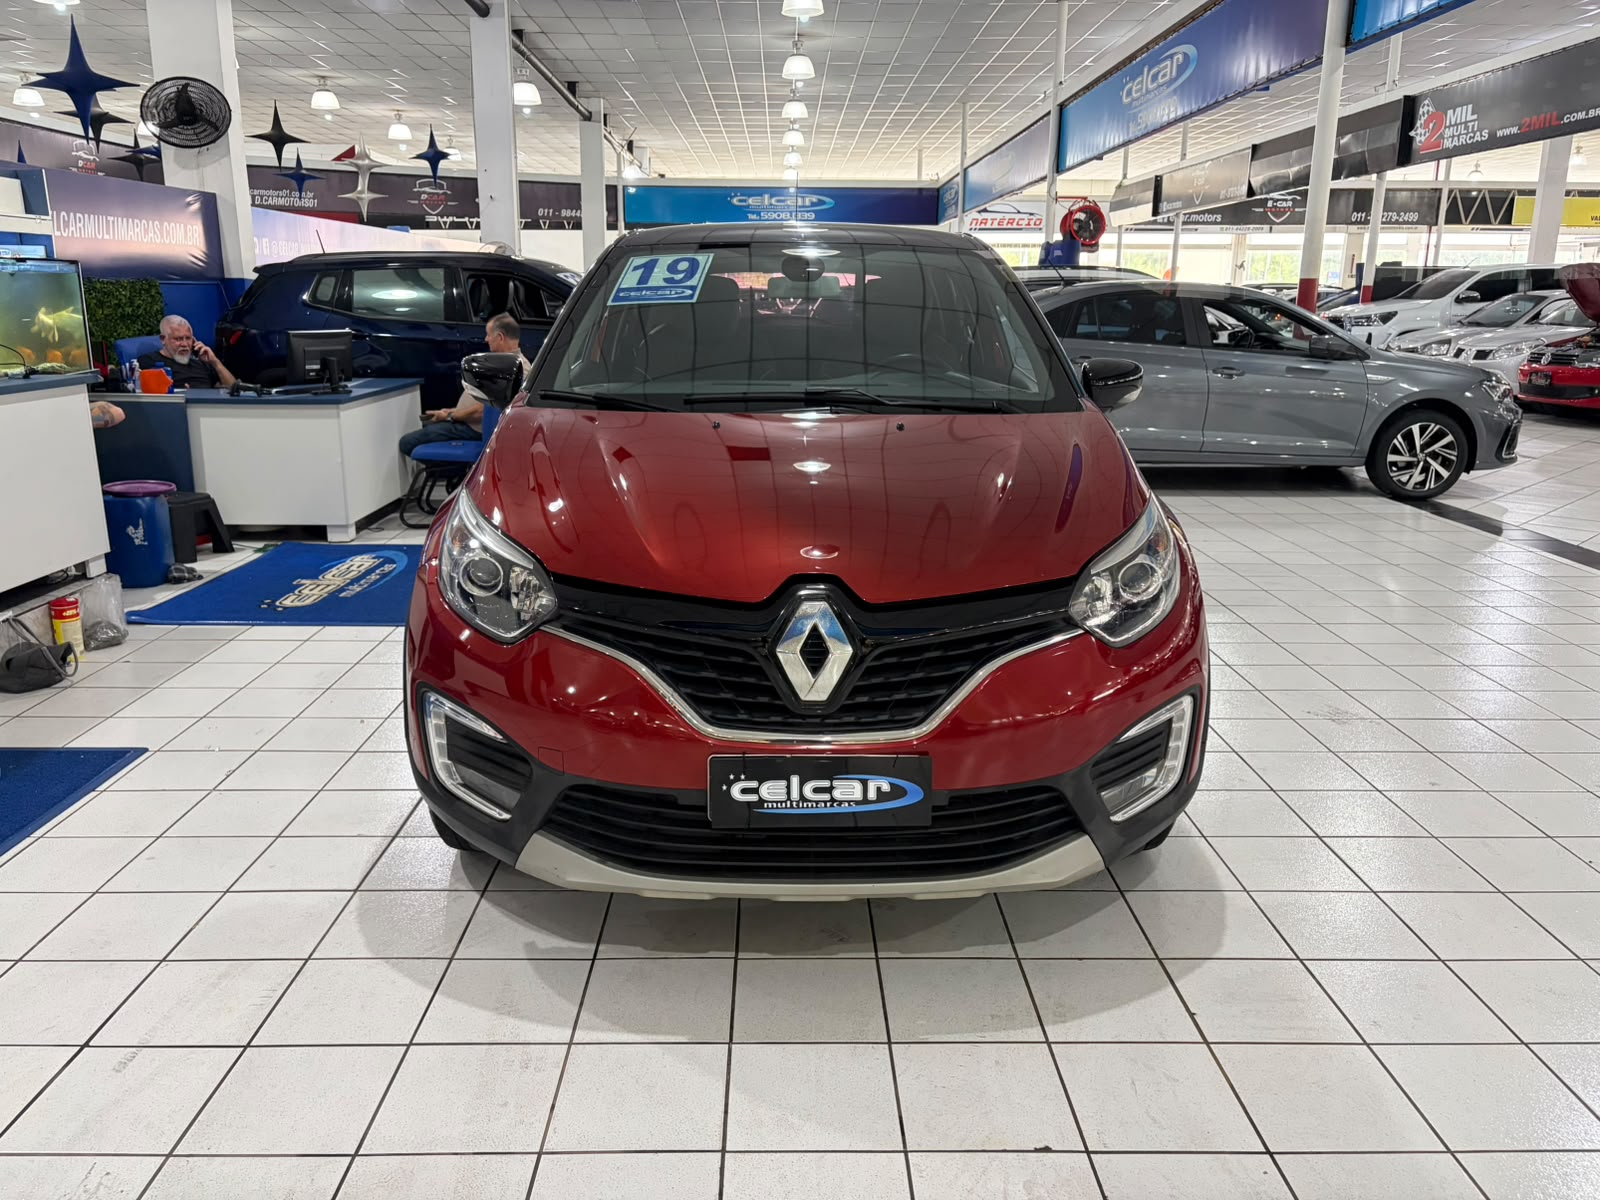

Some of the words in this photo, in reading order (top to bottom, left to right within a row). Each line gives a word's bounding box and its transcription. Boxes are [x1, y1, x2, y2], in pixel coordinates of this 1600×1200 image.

[1122, 53, 1184, 104] celcar
[1419, 111, 1446, 154] 2
[1446, 104, 1478, 126] MIL
[1443, 129, 1489, 150] MARCAS
[1444, 121, 1479, 138] MULTI
[731, 194, 818, 206] celcar
[538, 208, 553, 217] 011
[561, 208, 583, 217] 9844
[1351, 211, 1366, 222] 011
[1381, 211, 1419, 222] 279-2499
[50, 210, 201, 247] LCARMULTIMARCAS.COM.BR
[631, 256, 701, 286] 19
[730, 774, 891, 802] celcar
[764, 800, 857, 809] multimarcas
